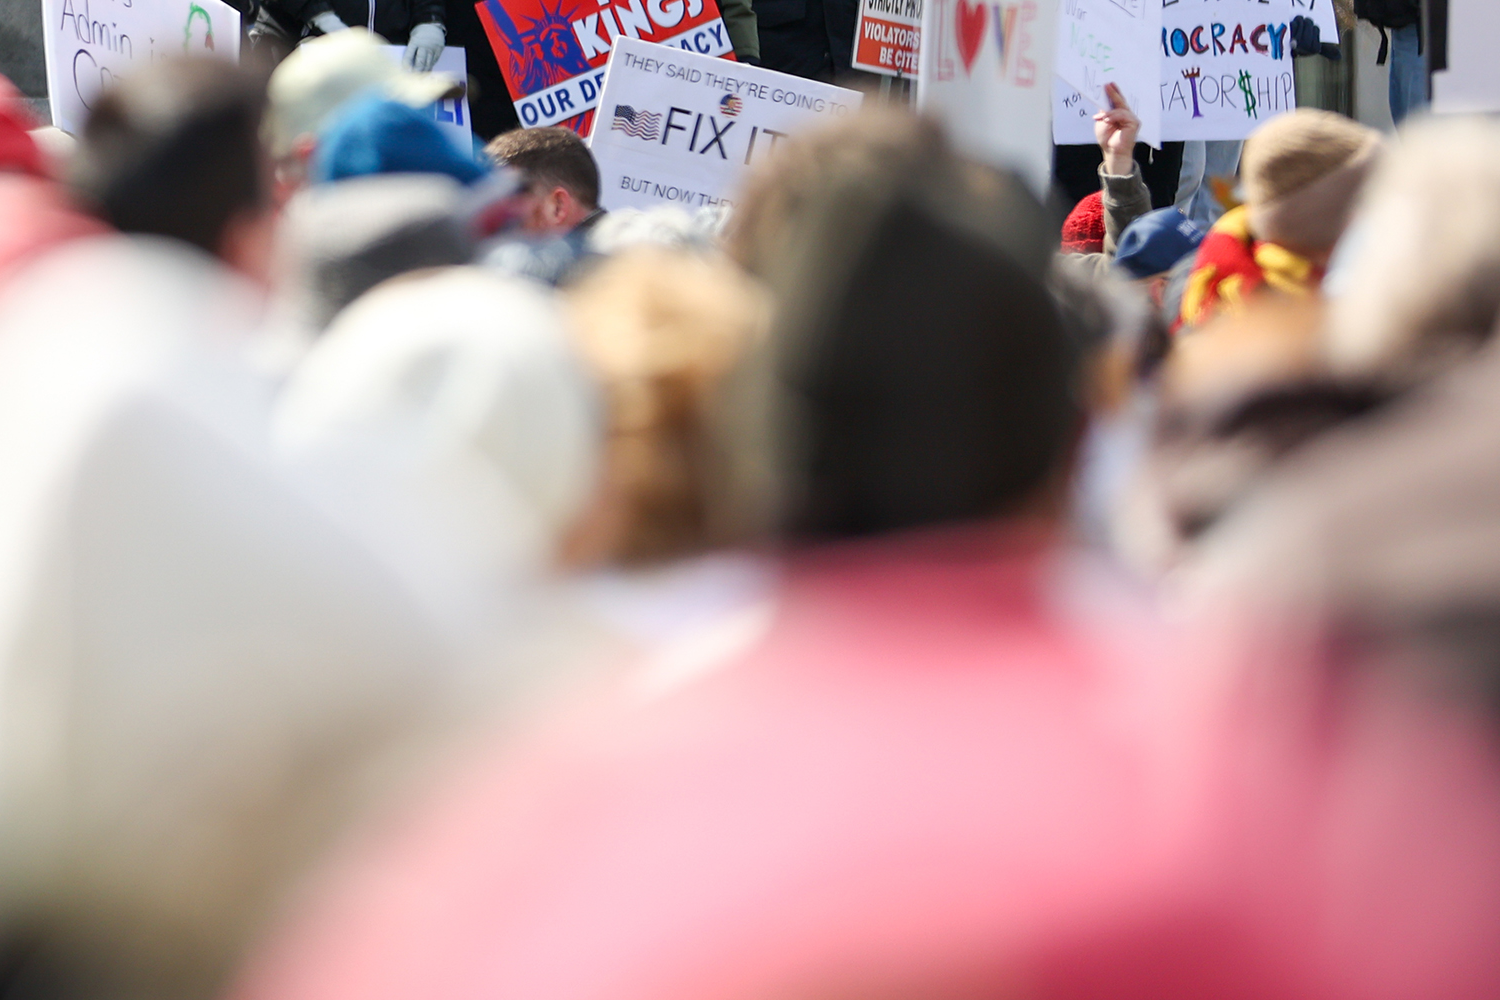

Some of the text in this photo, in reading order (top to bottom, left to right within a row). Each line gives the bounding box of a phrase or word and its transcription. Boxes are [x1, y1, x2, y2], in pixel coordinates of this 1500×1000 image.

[864, 21, 921, 48] VIOLATORS
[879, 47, 893, 66] BE
[624, 52, 849, 118] THEY SAID THEY'RE GOING TO
[520, 86, 575, 127] OUR
[661, 106, 790, 166] FIX IT
[621, 175, 652, 194] BUT
[653, 183, 695, 204] NOW
